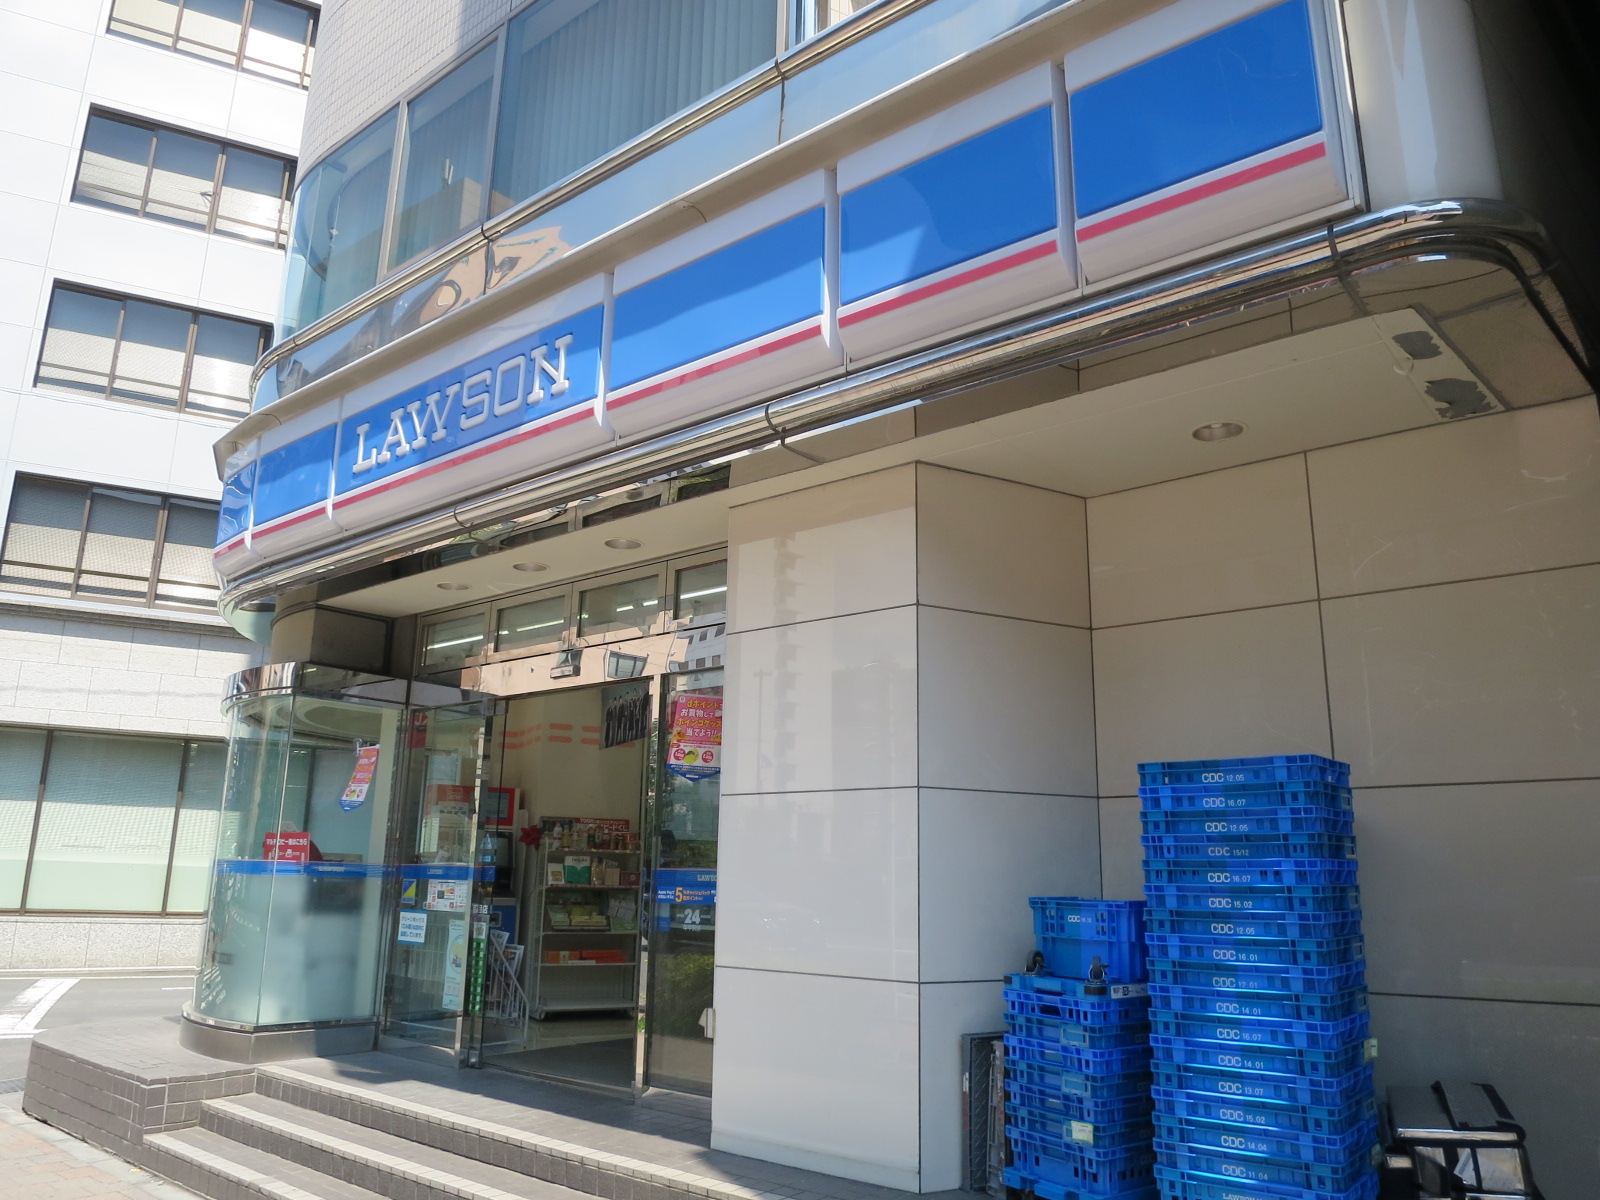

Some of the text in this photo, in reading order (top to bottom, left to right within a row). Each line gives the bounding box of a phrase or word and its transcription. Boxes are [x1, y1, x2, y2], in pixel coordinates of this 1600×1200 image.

[352, 333, 573, 475] LAWSON
[680, 708, 714, 718] お買物して
[1202, 772, 1224, 783] CDC
[1203, 798, 1225, 808] CDC
[1205, 822, 1227, 832] CDC
[1208, 847, 1230, 856] CDC
[1208, 873, 1230, 883] CDC
[675, 887, 683, 902] 5
[1209, 898, 1232, 908] CDC
[684, 909, 700, 924] 24
[1211, 923, 1234, 934] CDC
[1213, 950, 1258, 961] CDC 16.01
[1212, 977, 1236, 988] CDC
[1216, 1002, 1261, 1015] CDC 14.01
[1217, 1028, 1240, 1040] CDC
[1218, 1055, 1264, 1069] CDC 14.01
[1219, 1082, 1264, 1096] CDC 13.07
[1220, 1109, 1266, 1124] CDC 15.02
[1221, 1135, 1267, 1151] CDC 14.04
[1222, 1164, 1246, 1177] CDC
